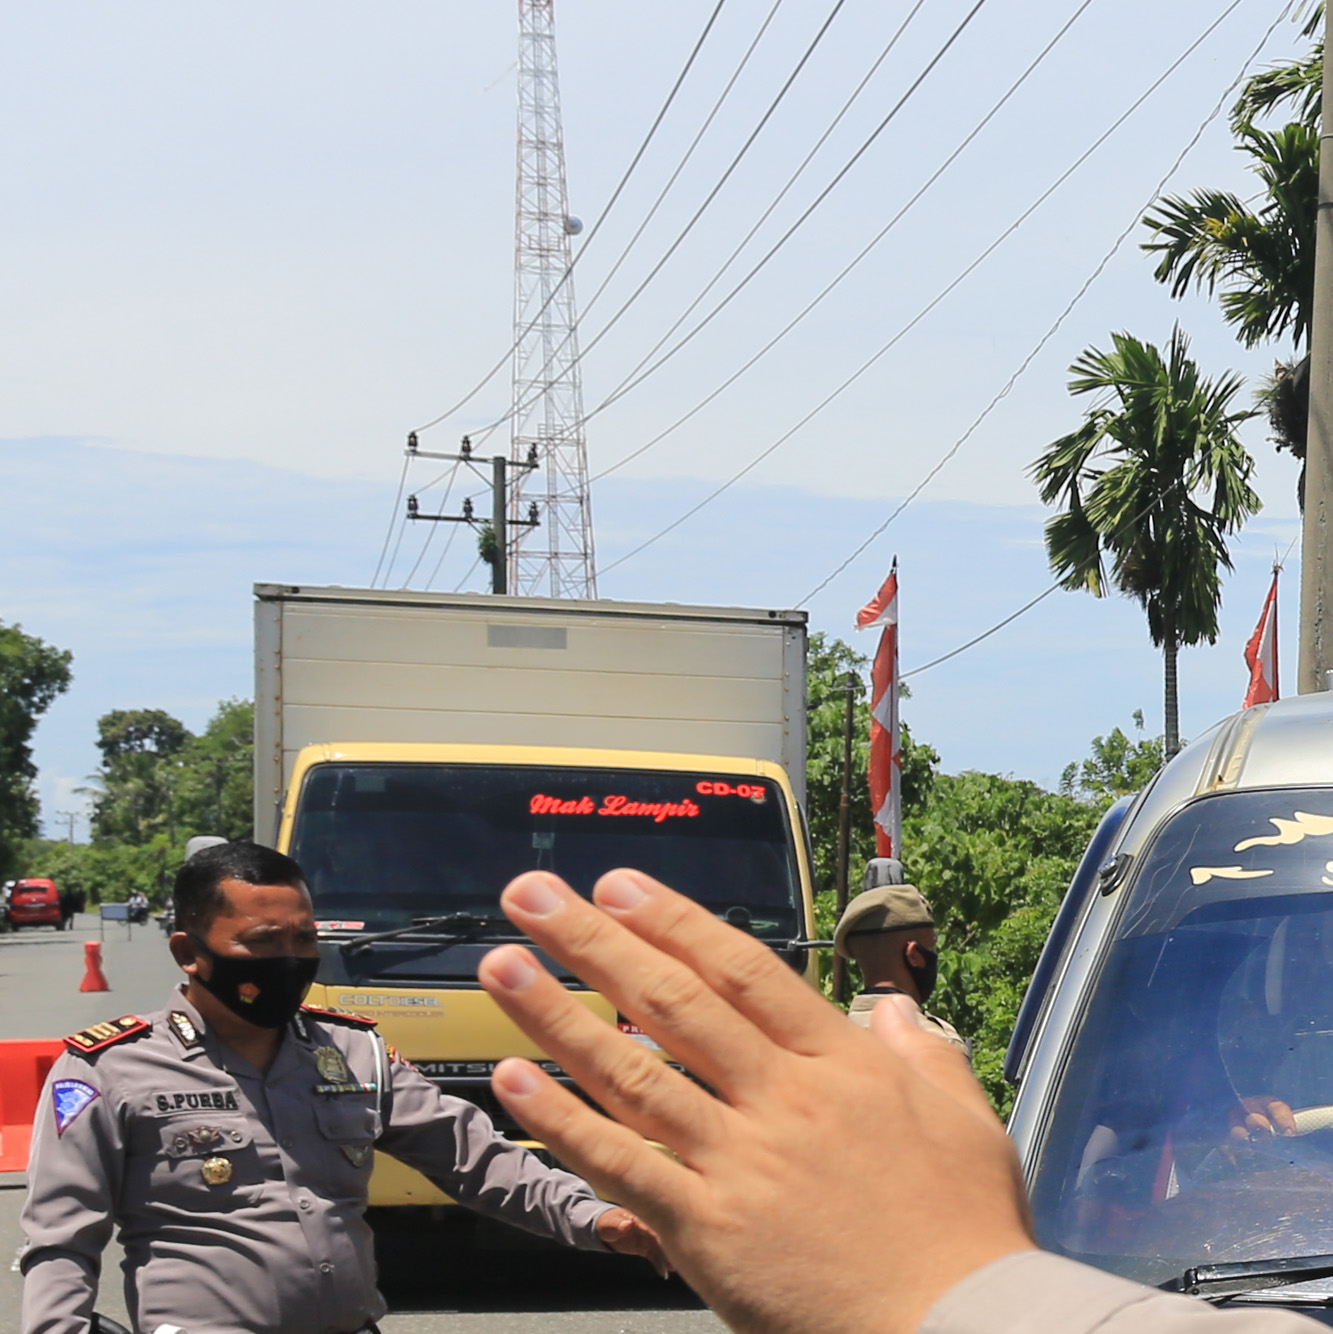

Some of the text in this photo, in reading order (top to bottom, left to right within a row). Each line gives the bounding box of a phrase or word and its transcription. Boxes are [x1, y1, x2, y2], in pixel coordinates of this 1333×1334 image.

[696, 782, 766, 798] CD-07
[529, 794, 700, 823] Mak Lampir
[339, 993, 445, 1008] COLT DIESEL
[155, 1091, 239, 1112] S.PURBA
